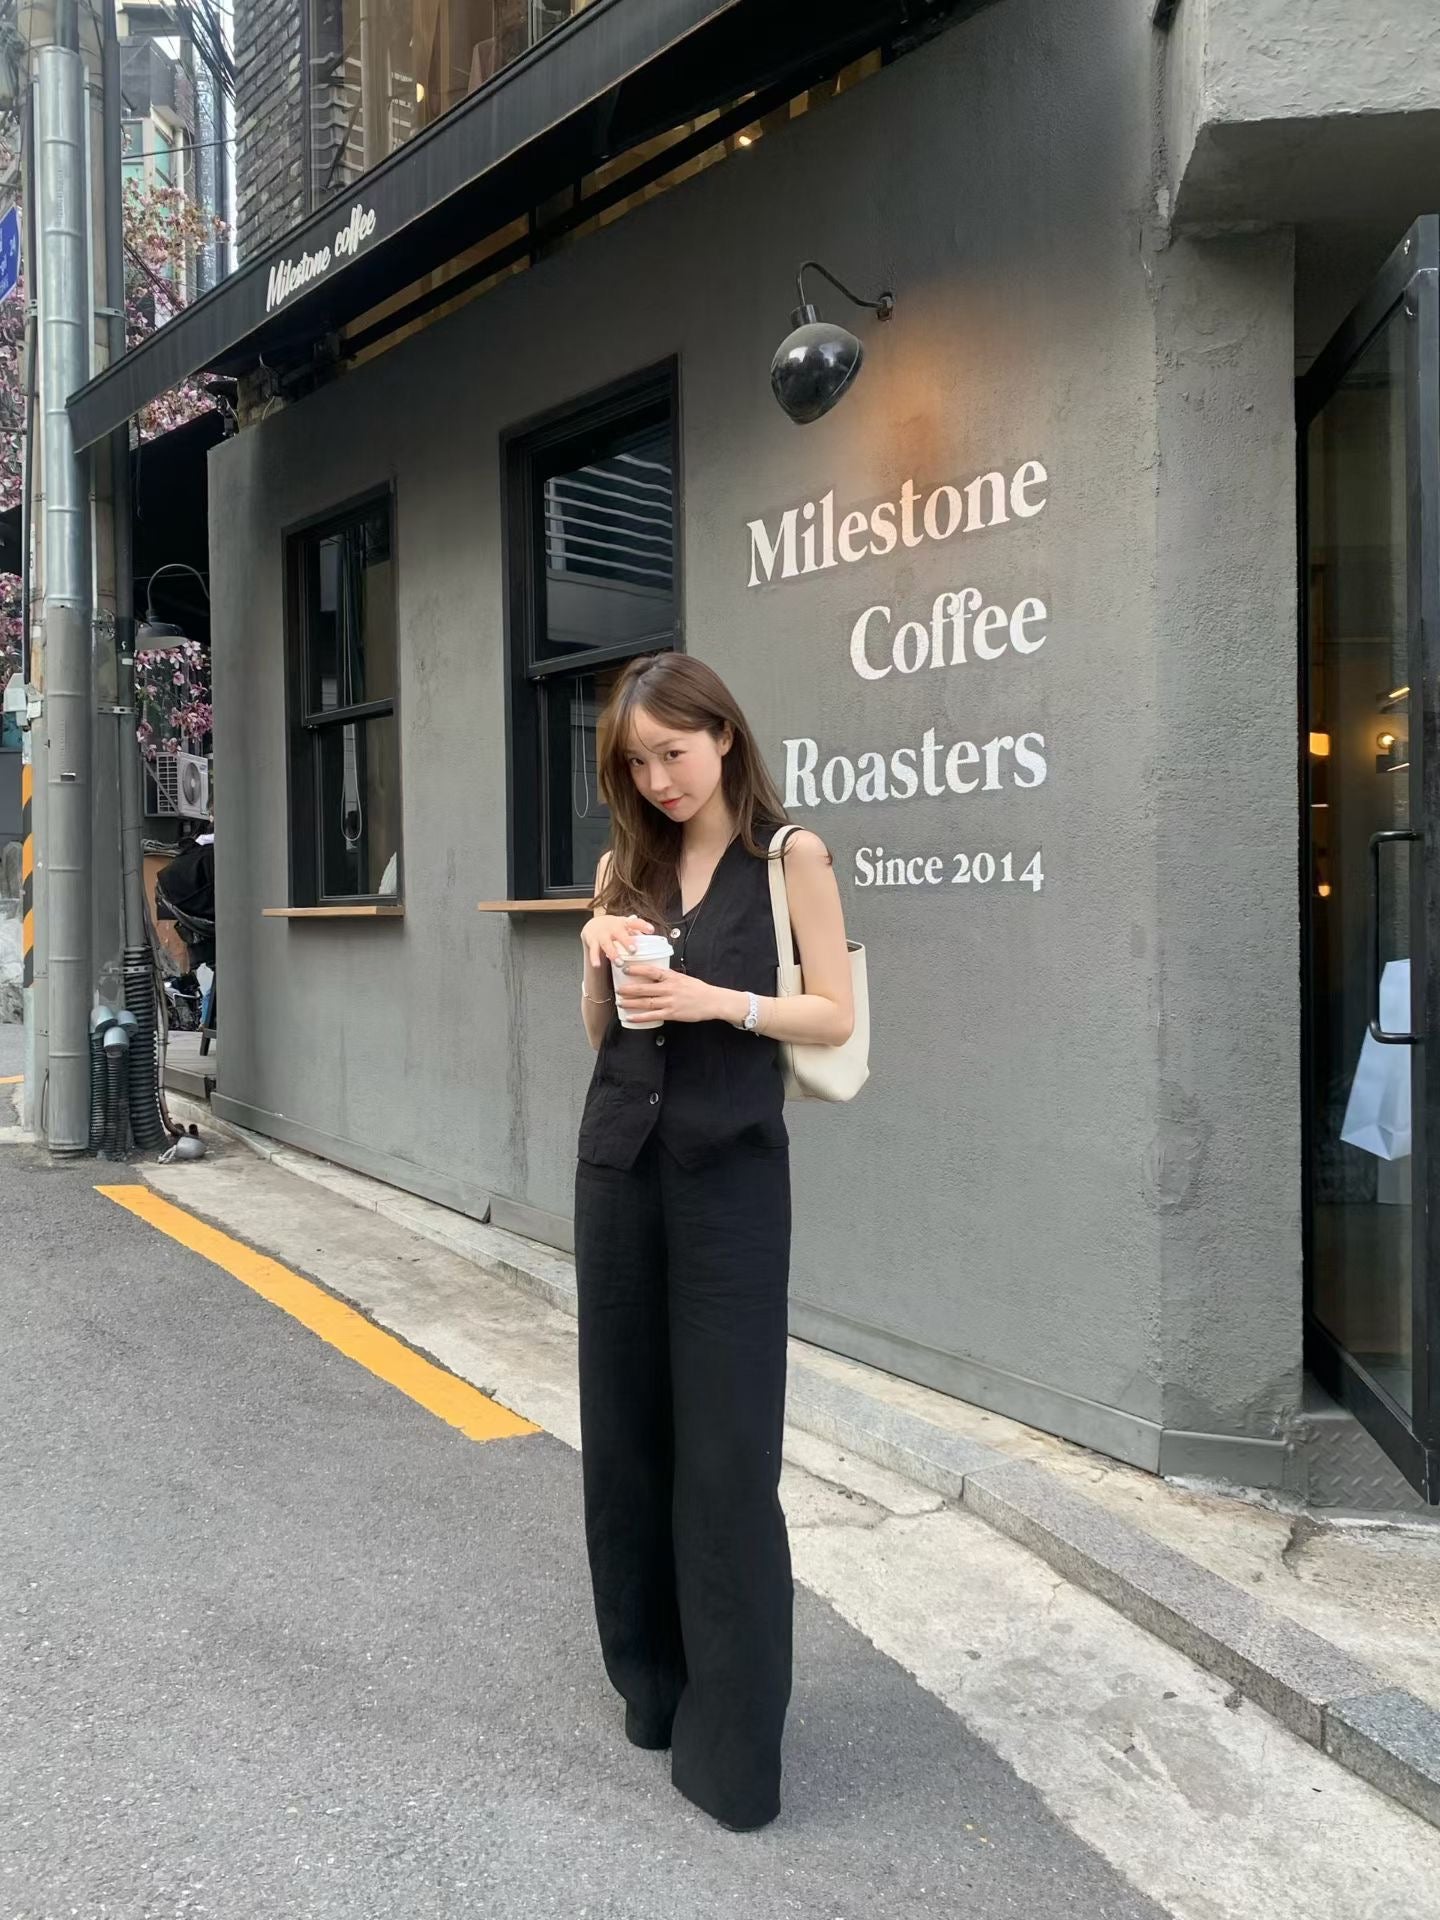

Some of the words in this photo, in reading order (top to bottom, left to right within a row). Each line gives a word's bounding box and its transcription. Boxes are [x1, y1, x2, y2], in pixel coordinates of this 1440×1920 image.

[266, 245, 331, 312] Milestone
[334, 203, 377, 256] coffee
[746, 460, 1047, 588] Milestone
[850, 588, 1047, 680] Coffee
[783, 727, 1047, 809] Roasters
[855, 847, 943, 887] Since
[952, 851, 1044, 892] 2014
